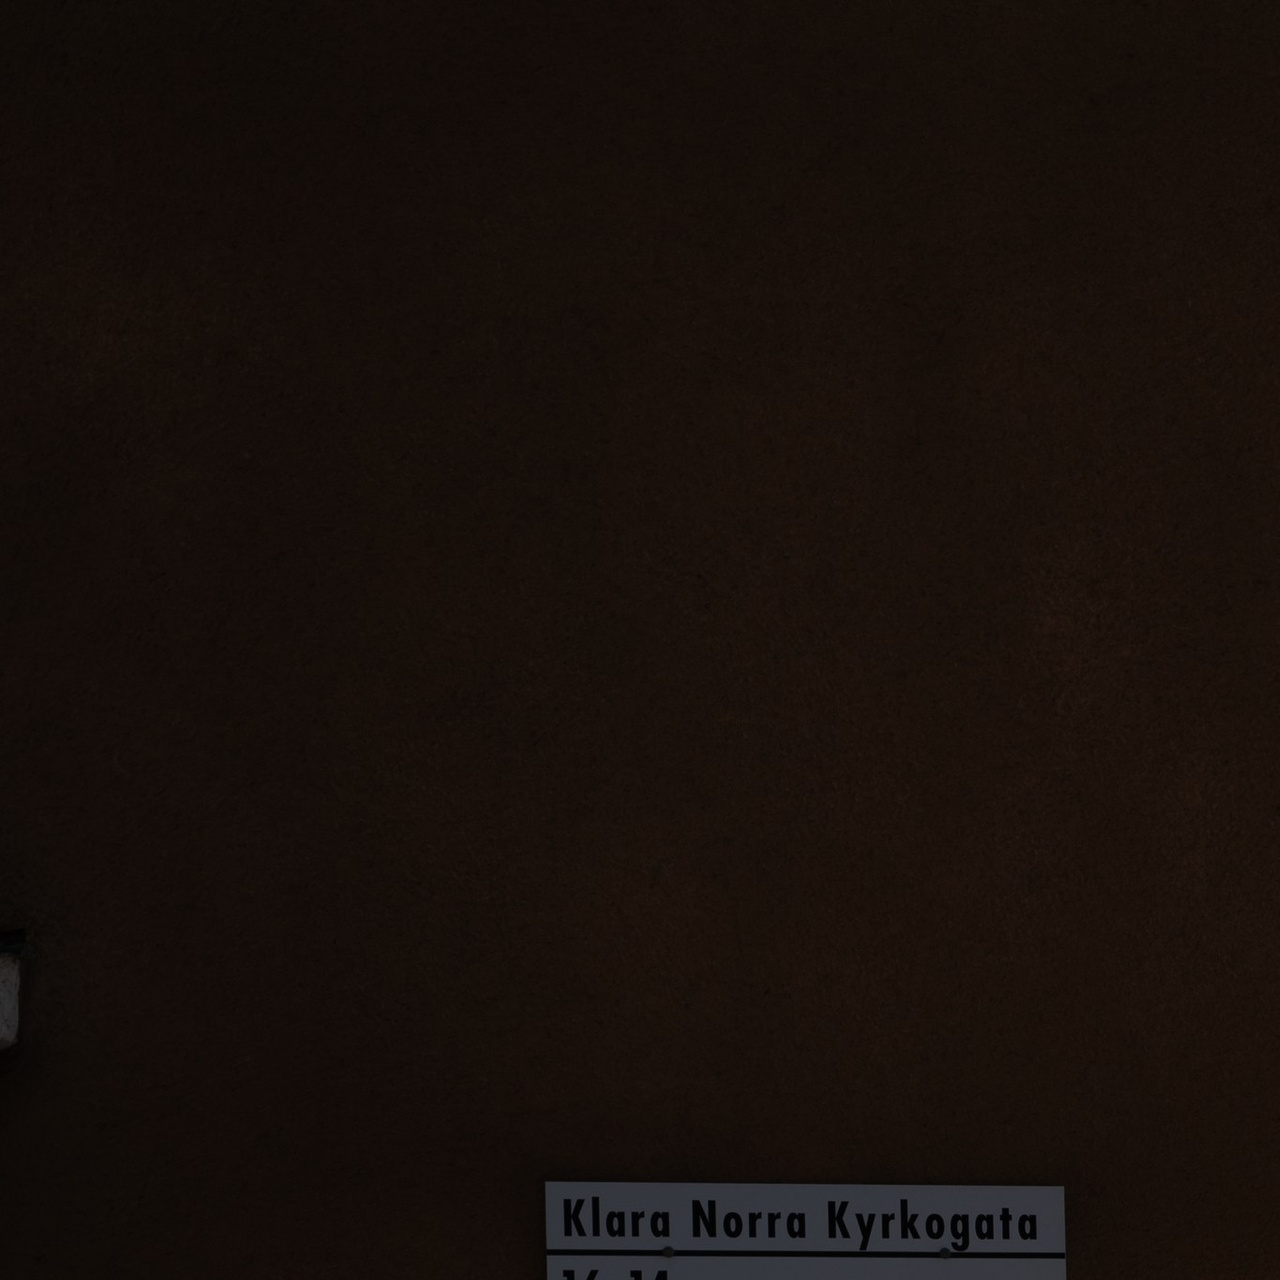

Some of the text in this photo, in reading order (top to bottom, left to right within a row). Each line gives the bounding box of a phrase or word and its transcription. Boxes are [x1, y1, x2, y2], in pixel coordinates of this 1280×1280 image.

[563, 1196, 1038, 1251] Klara Norra Kyrkogata
